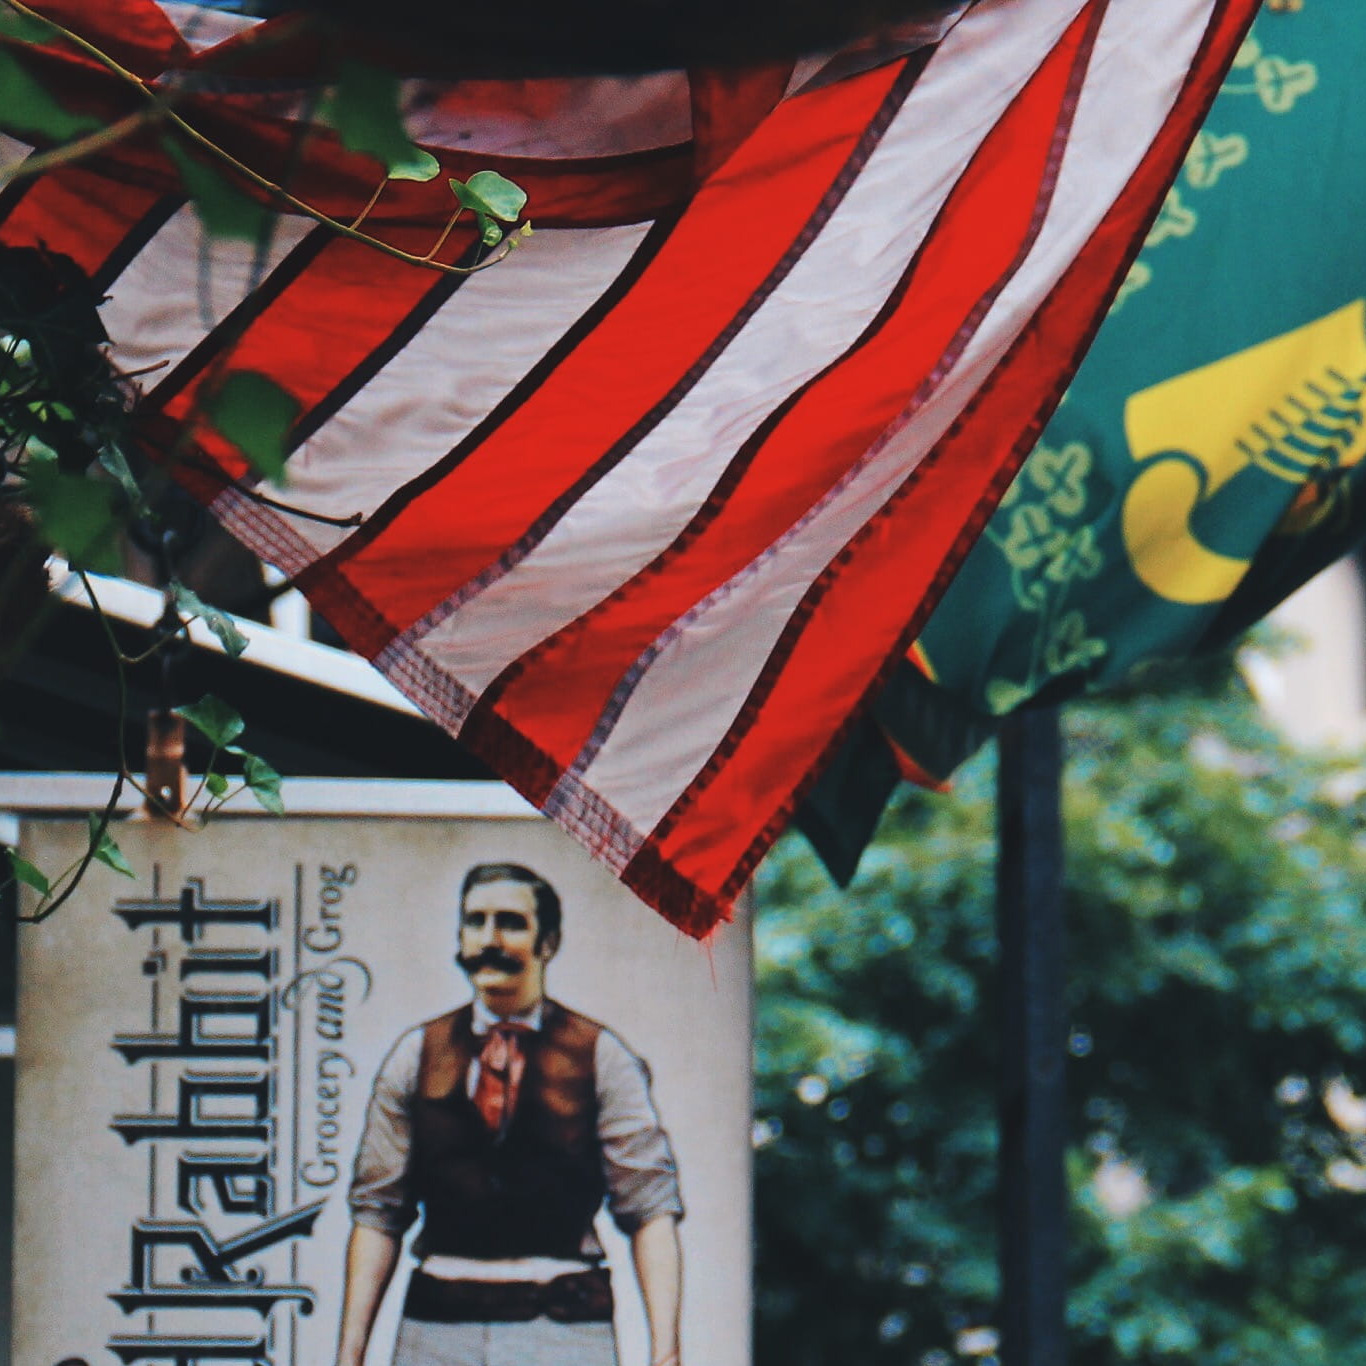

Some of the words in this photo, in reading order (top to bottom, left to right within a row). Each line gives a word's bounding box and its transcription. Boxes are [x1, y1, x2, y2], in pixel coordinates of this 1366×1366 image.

[302, 863, 359, 954] Grog
[283, 957, 372, 1041] and
[107, 876, 327, 1316] Rabbit
[299, 1047, 355, 1188] Grocery
